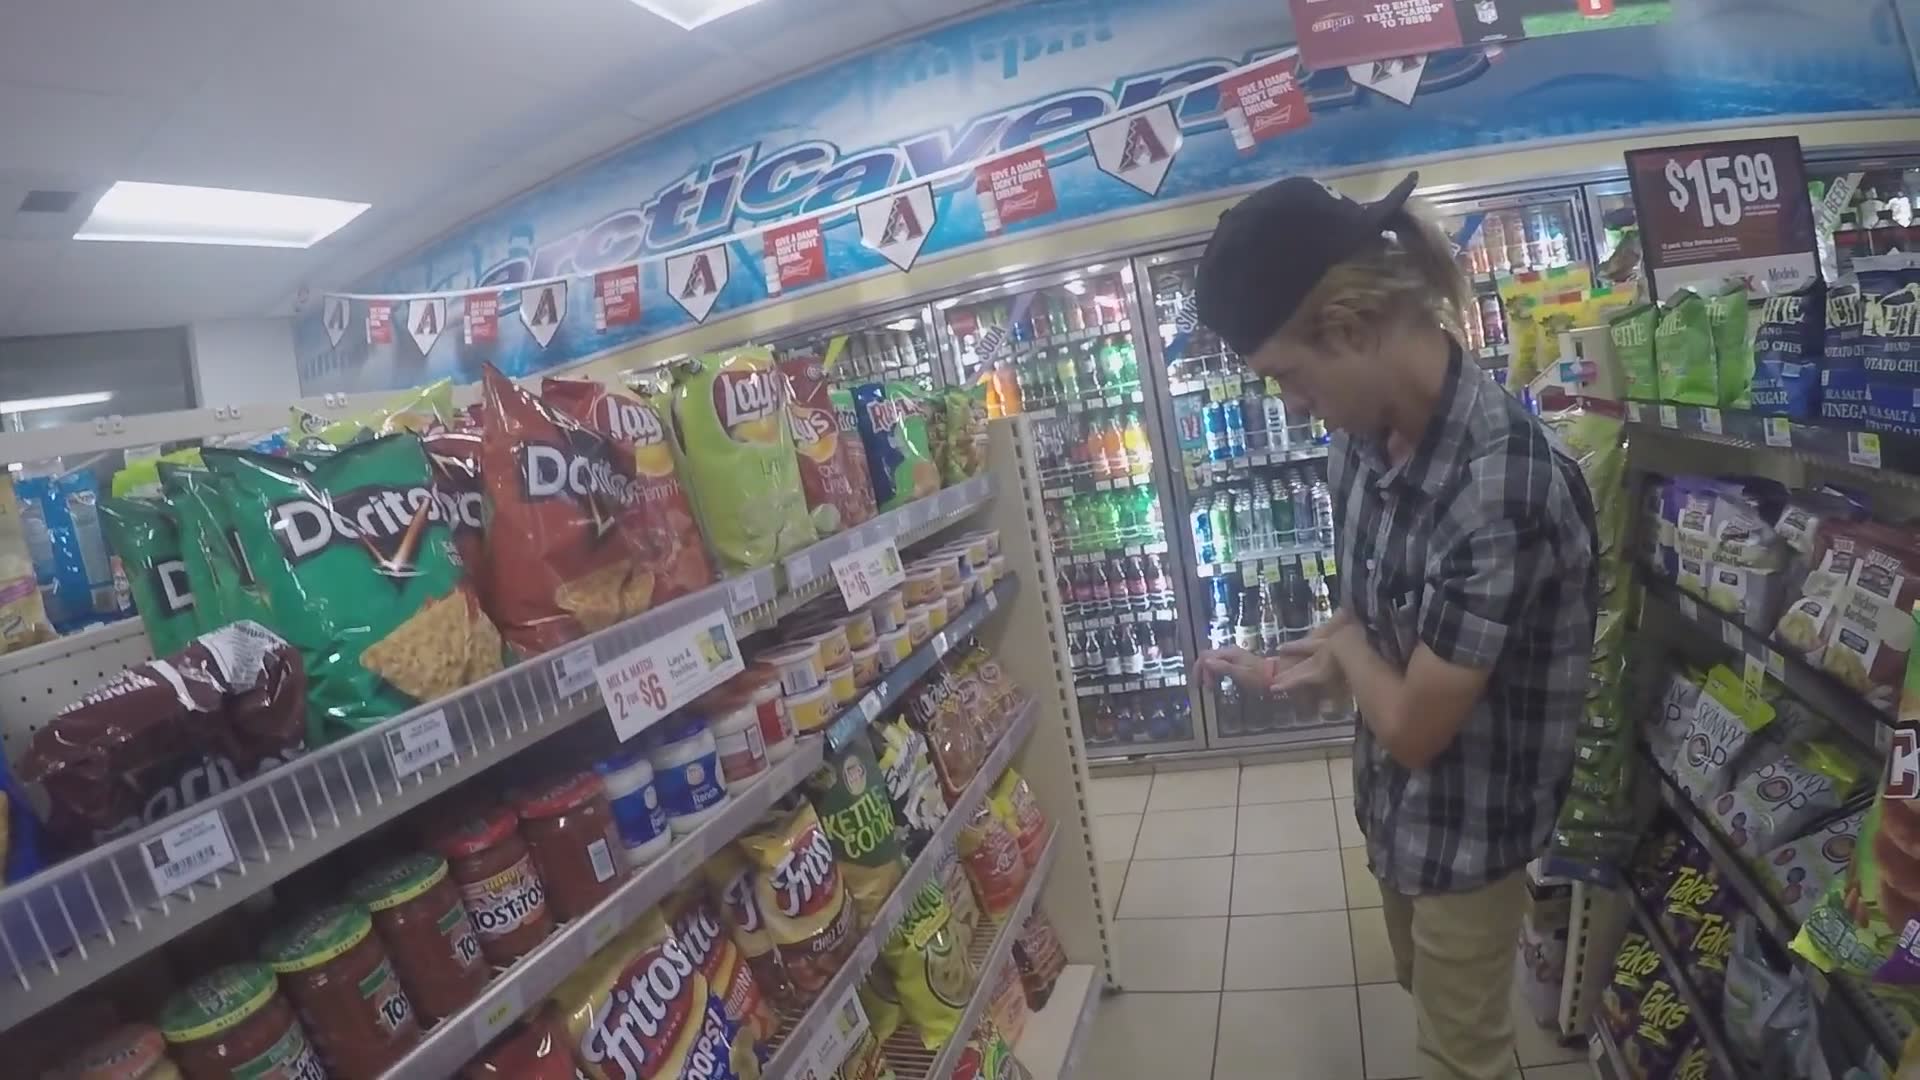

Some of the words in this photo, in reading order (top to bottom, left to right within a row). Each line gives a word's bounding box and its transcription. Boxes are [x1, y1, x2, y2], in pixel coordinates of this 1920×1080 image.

[1363, 10, 1394, 23] TEXT
[1374, 3, 1390, 13] TO
[1391, 0, 1430, 11] ENTER
[1380, 19, 1397, 28] TO
[1237, 81, 1258, 96] GIVE
[1257, 80, 1265, 90] A
[1267, 80, 1295, 98] DRIVE
[992, 168, 1009, 182] GIVE
[1010, 165, 1018, 176] A
[1017, 168, 1044, 184] DRIVE
[1824, 178, 1850, 216] BEER
[975, 325, 1006, 360] SODA
[1821, 401, 1867, 419] VINEGA
[606, 673, 622, 690] MIX
[628, 656, 654, 679] MATCH
[614, 691, 629, 720] 2
[639, 673, 667, 711] $6
[1698, 701, 1745, 750] SKINNY
[843, 801, 895, 860] COOK
[769, 828, 833, 918] Frito
[1664, 866, 1720, 905] Takis
[1689, 912, 1731, 958] Tak
[1639, 979, 1691, 1031] Takis
[686, 1007, 724, 1080] OOPS!
